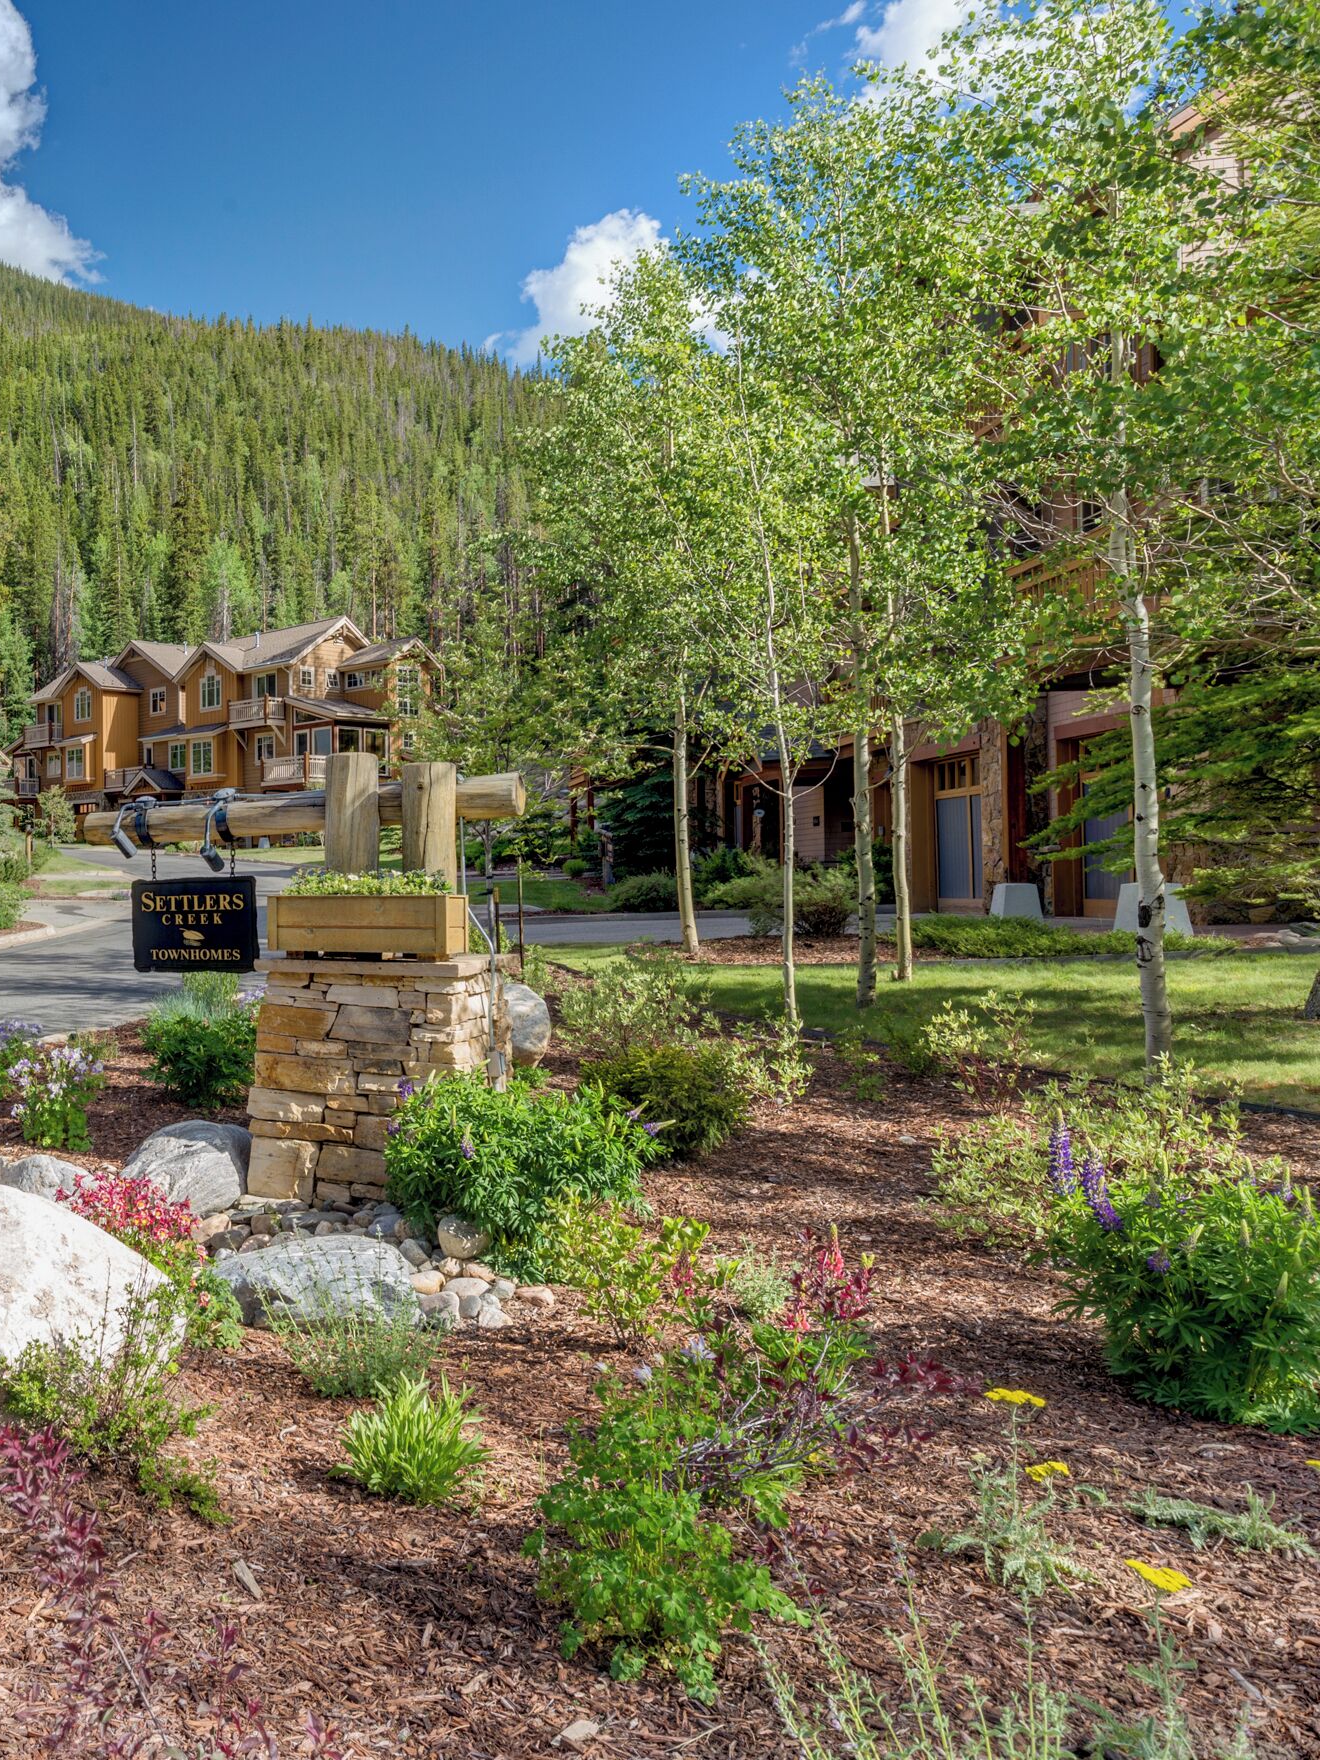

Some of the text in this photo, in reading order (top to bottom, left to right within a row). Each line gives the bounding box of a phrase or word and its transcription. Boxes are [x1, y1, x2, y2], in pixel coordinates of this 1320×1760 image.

[141, 891, 244, 912] SETTLERS
[162, 913, 223, 925] CREEK
[151, 948, 241, 961] TOWNHOMES
